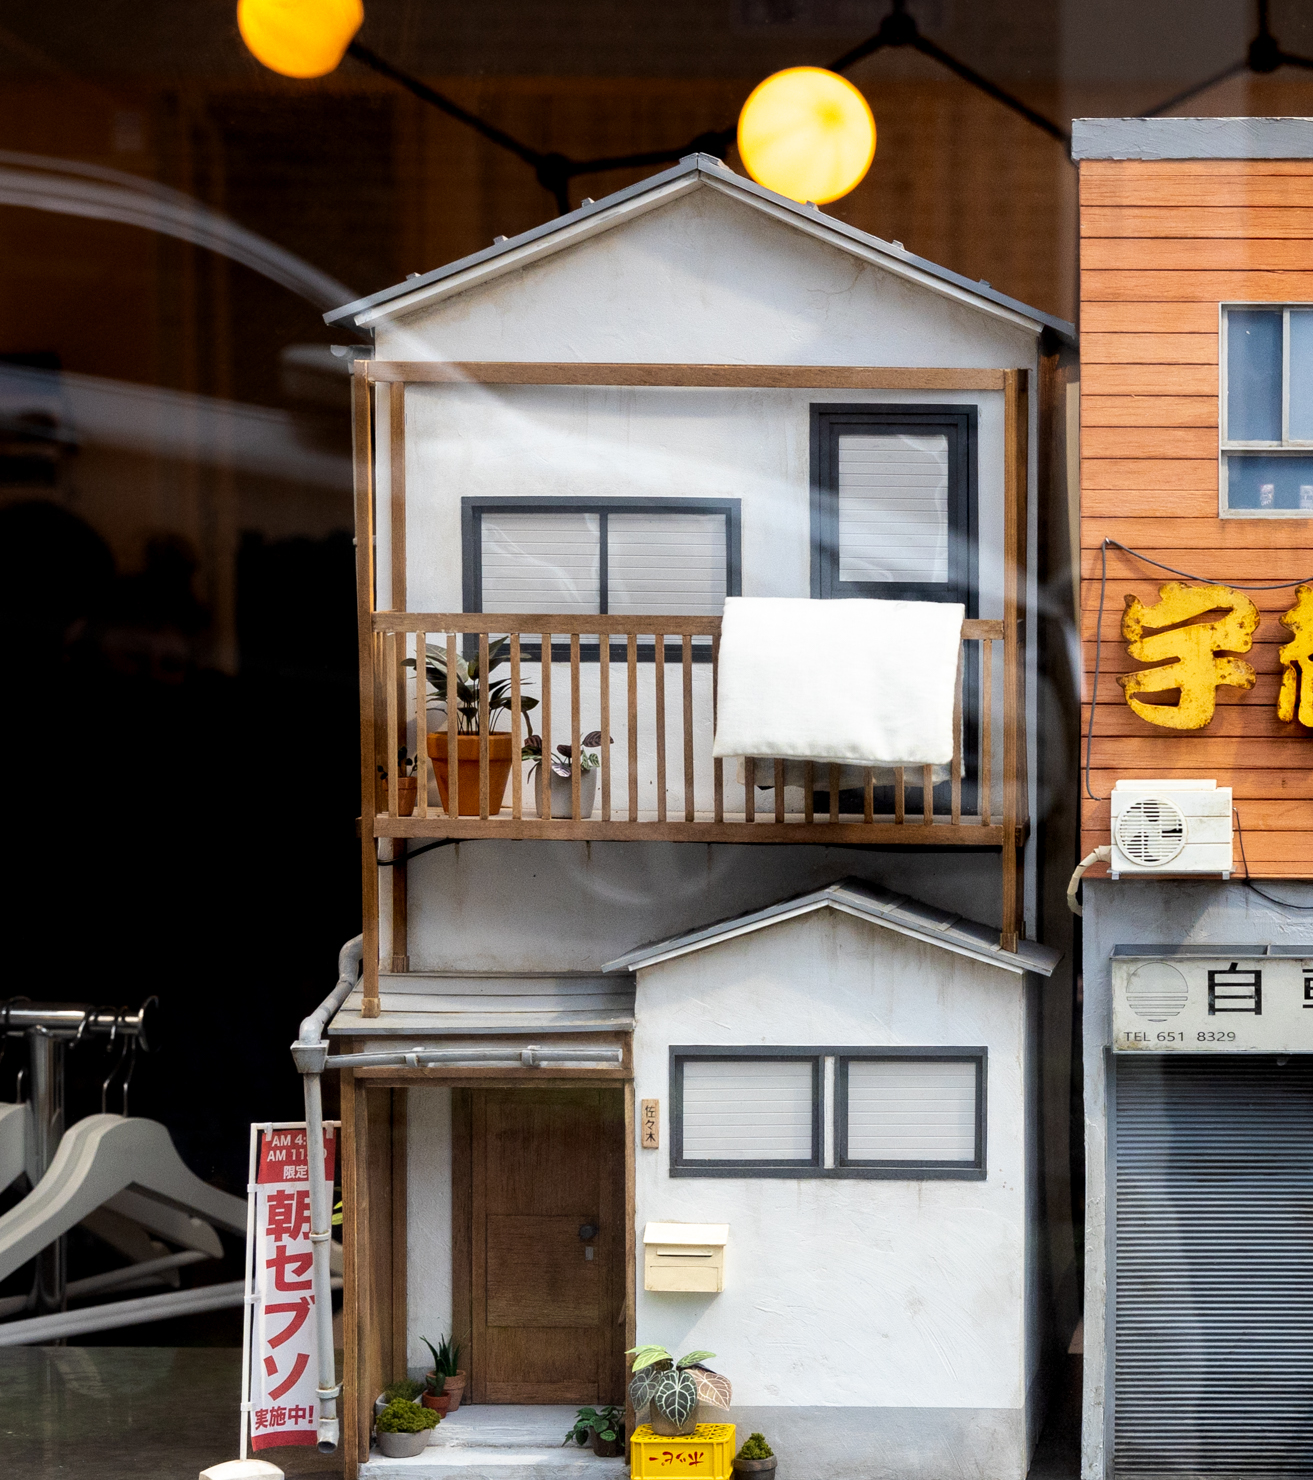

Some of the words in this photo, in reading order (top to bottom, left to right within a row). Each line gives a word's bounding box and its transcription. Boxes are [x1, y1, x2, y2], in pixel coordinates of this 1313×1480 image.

[1124, 1031, 1151, 1043] TEL
[1156, 1031, 1185, 1043] 651
[1196, 1031, 1236, 1043] 8329
[644, 1105, 656, 1143] 佐々木
[271, 1135, 291, 1147] AM
[267, 1149, 286, 1162] AM
[283, 1165, 308, 1180] 限定
[254, 1405, 315, 1431] 実施中!
[649, 1451, 704, 1467] ホッピー
